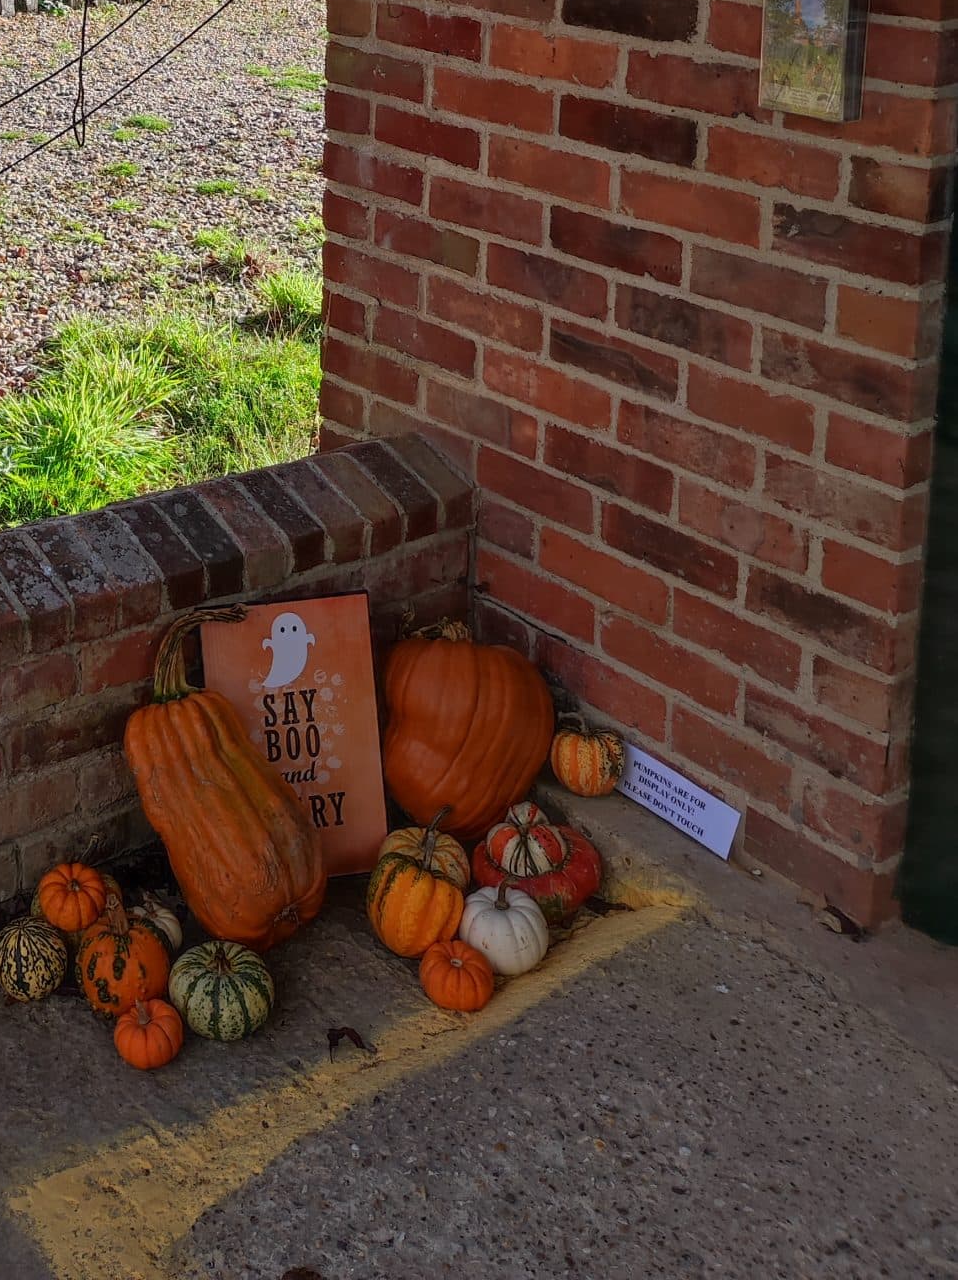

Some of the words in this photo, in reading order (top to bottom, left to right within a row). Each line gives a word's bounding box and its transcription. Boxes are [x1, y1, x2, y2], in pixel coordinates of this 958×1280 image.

[263, 688, 317, 727] SAY
[265, 724, 320, 762] BOO
[633, 760, 672, 788] PUMPKINS
[673, 785, 689, 800] ARE
[690, 795, 706, 811] FOR
[638, 775, 669, 799] DISPLAY
[670, 795, 695, 816] ONLY!
[623, 780, 652, 803] PLEASE
[652, 798, 676, 818] DON'T
[676, 813, 705, 837] TOUCH
